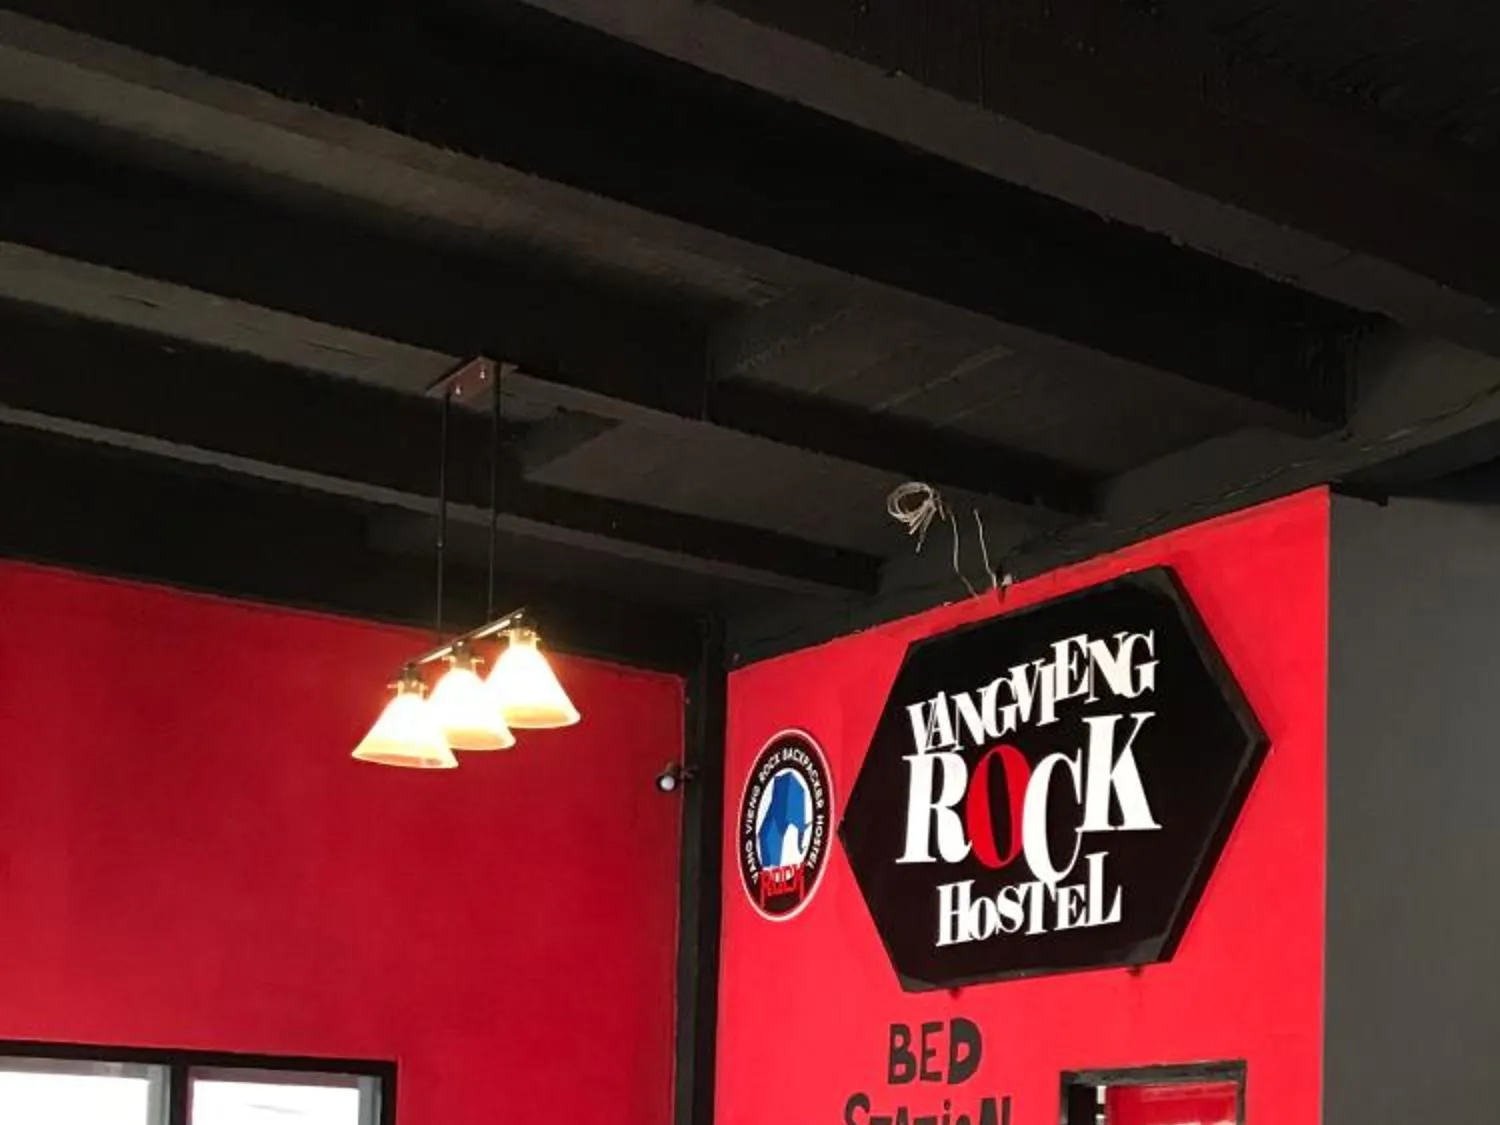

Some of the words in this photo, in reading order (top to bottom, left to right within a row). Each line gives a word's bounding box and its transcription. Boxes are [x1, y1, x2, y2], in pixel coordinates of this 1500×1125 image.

[895, 711, 1162, 884] ROCK
[936, 851, 1122, 947] HOSTEL
[888, 1017, 983, 1085] BED
